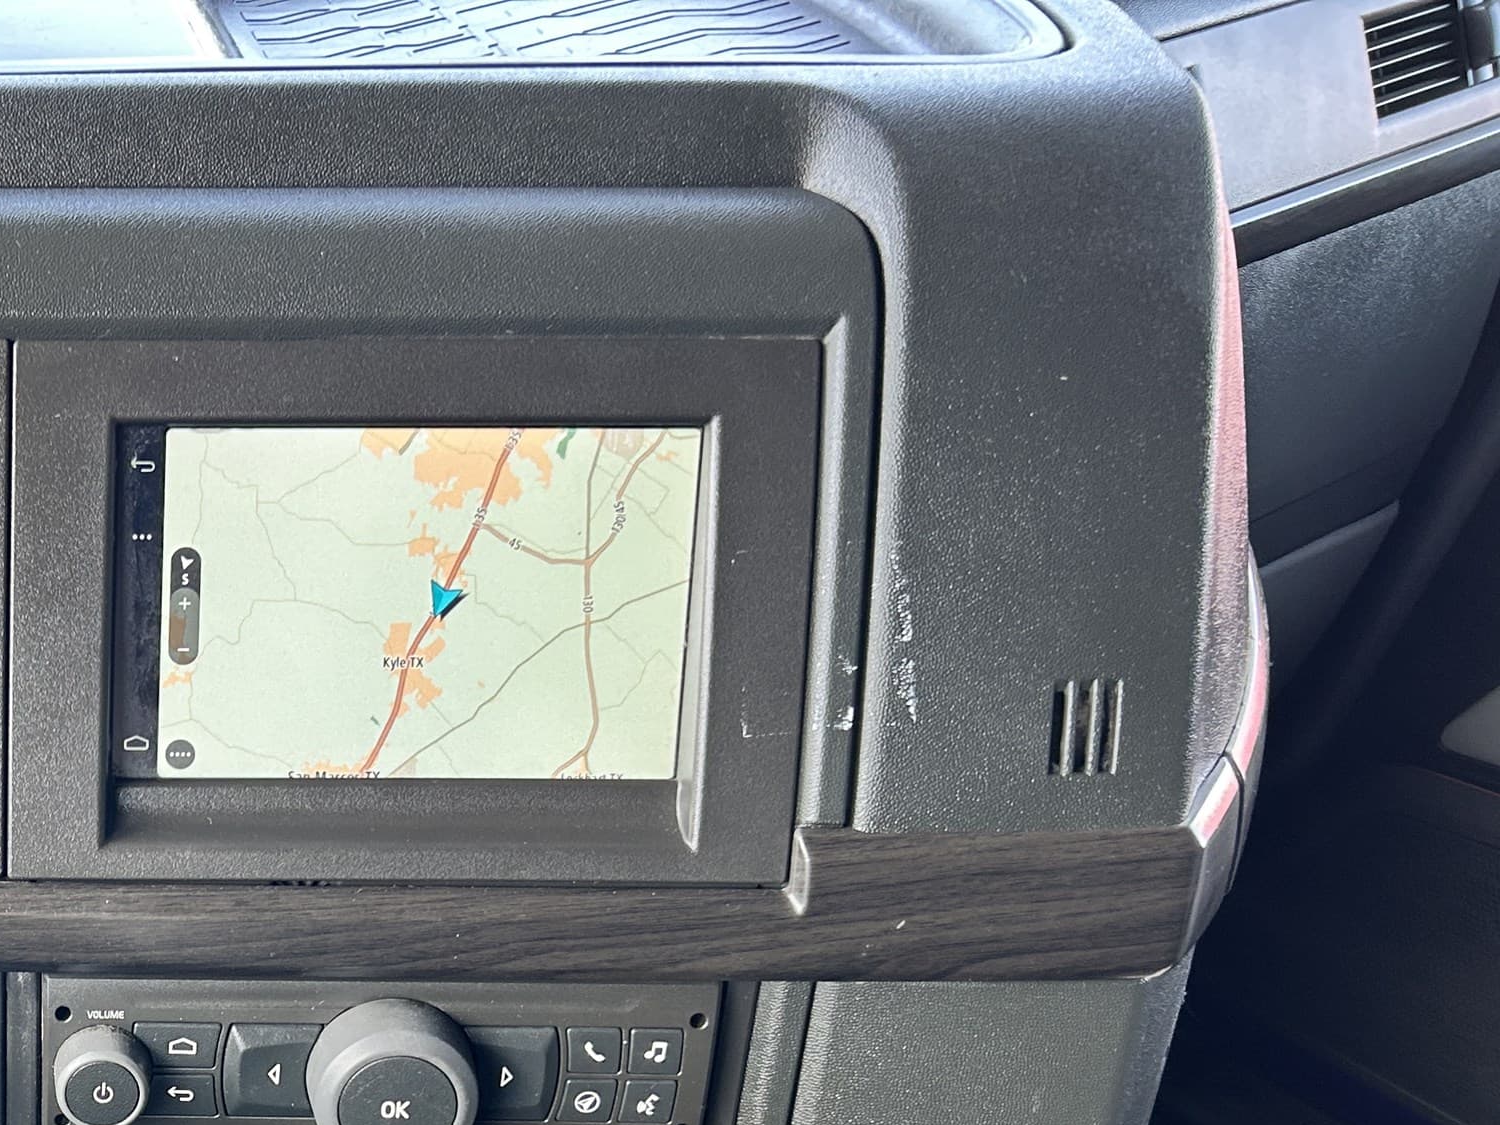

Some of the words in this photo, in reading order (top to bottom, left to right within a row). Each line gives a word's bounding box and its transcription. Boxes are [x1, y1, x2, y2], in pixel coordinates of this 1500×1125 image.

[508, 538, 522, 550] 45
[181, 572, 190, 586] S
[582, 595, 594, 614] 130
[383, 656, 406, 671] Kyle
[410, 656, 424, 668] TX
[86, 1010, 125, 1020] VOLUME
[380, 1100, 411, 1119] OK
